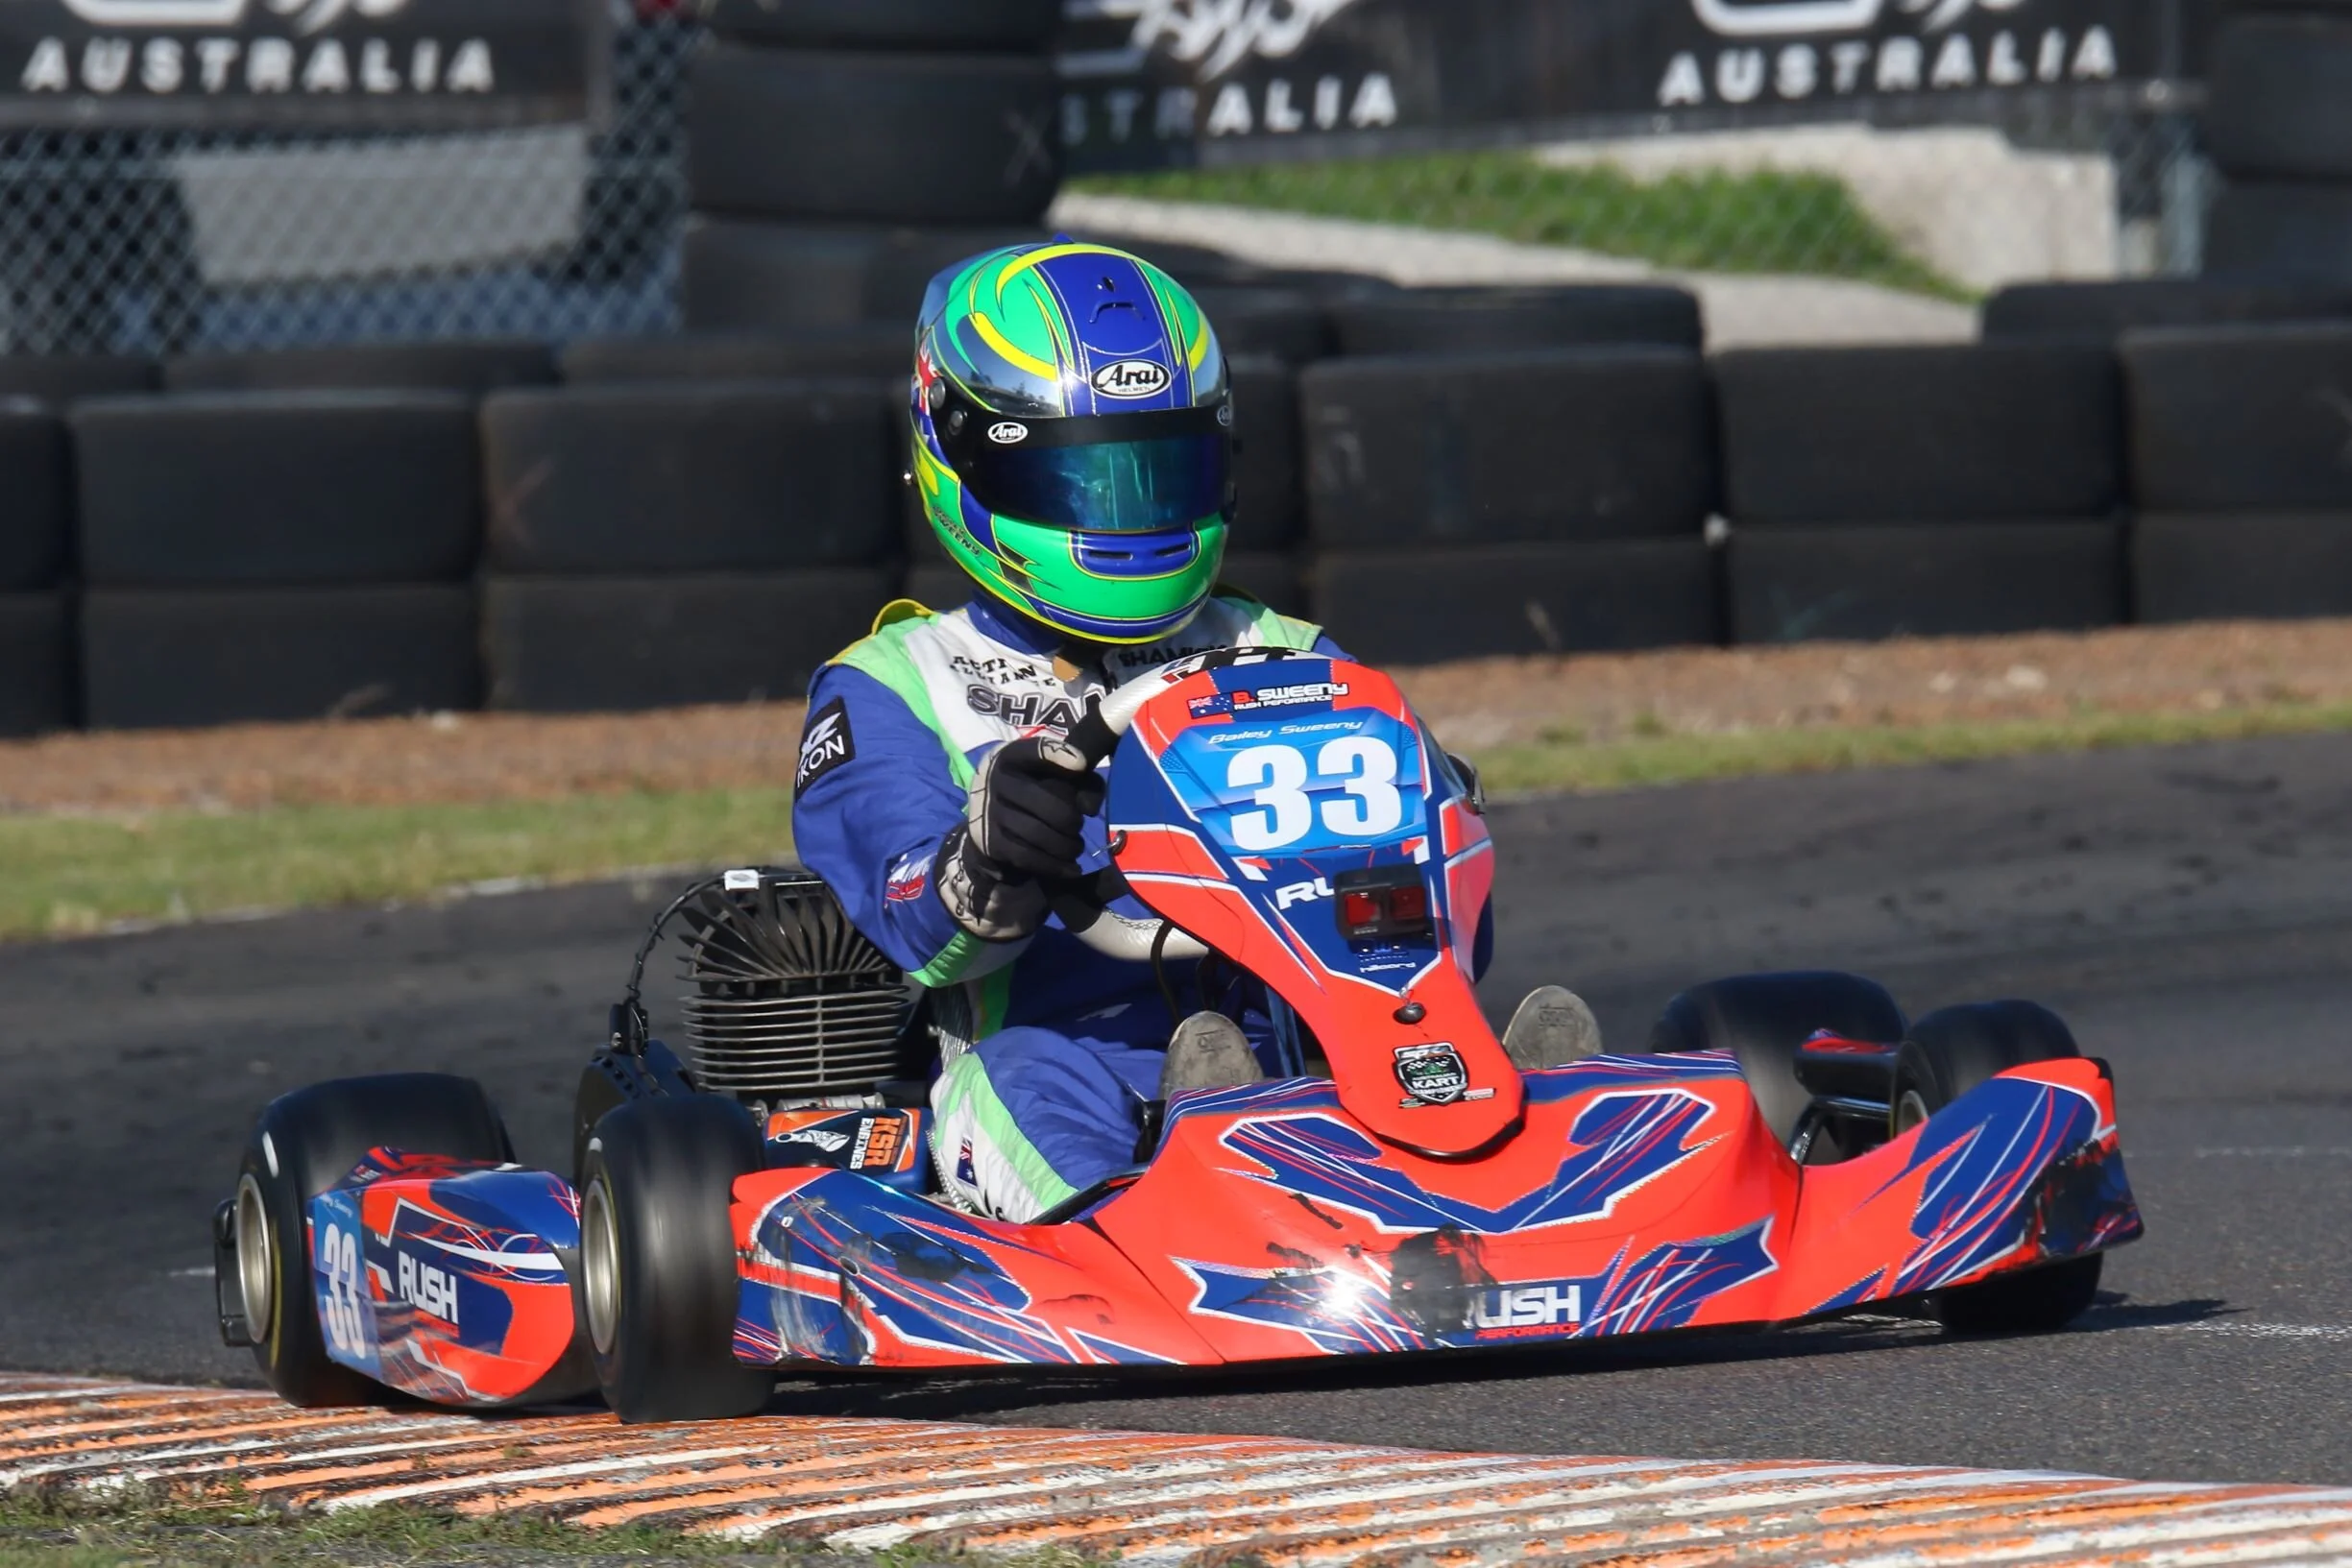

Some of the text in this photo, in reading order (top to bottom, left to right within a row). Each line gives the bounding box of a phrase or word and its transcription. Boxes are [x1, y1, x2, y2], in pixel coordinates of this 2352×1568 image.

[20, 36, 495, 94] AUSTRALIA
[1657, 23, 2119, 108] AUSTRALIA
[1098, 364, 1161, 389] Arai
[991, 424, 1024, 438] Arai
[1233, 702, 1262, 711] RUSH
[1208, 721, 1364, 745] Bailey Sweeny
[1227, 736, 1402, 852] 33
[1411, 1076, 1460, 1090] KART
[849, 1117, 875, 1170] ENGINES
[863, 1117, 902, 1167] KSR
[324, 1223, 366, 1359] 33
[398, 1250, 459, 1325] RUSH
[1475, 1322, 1580, 1340] PERFORMANCE
